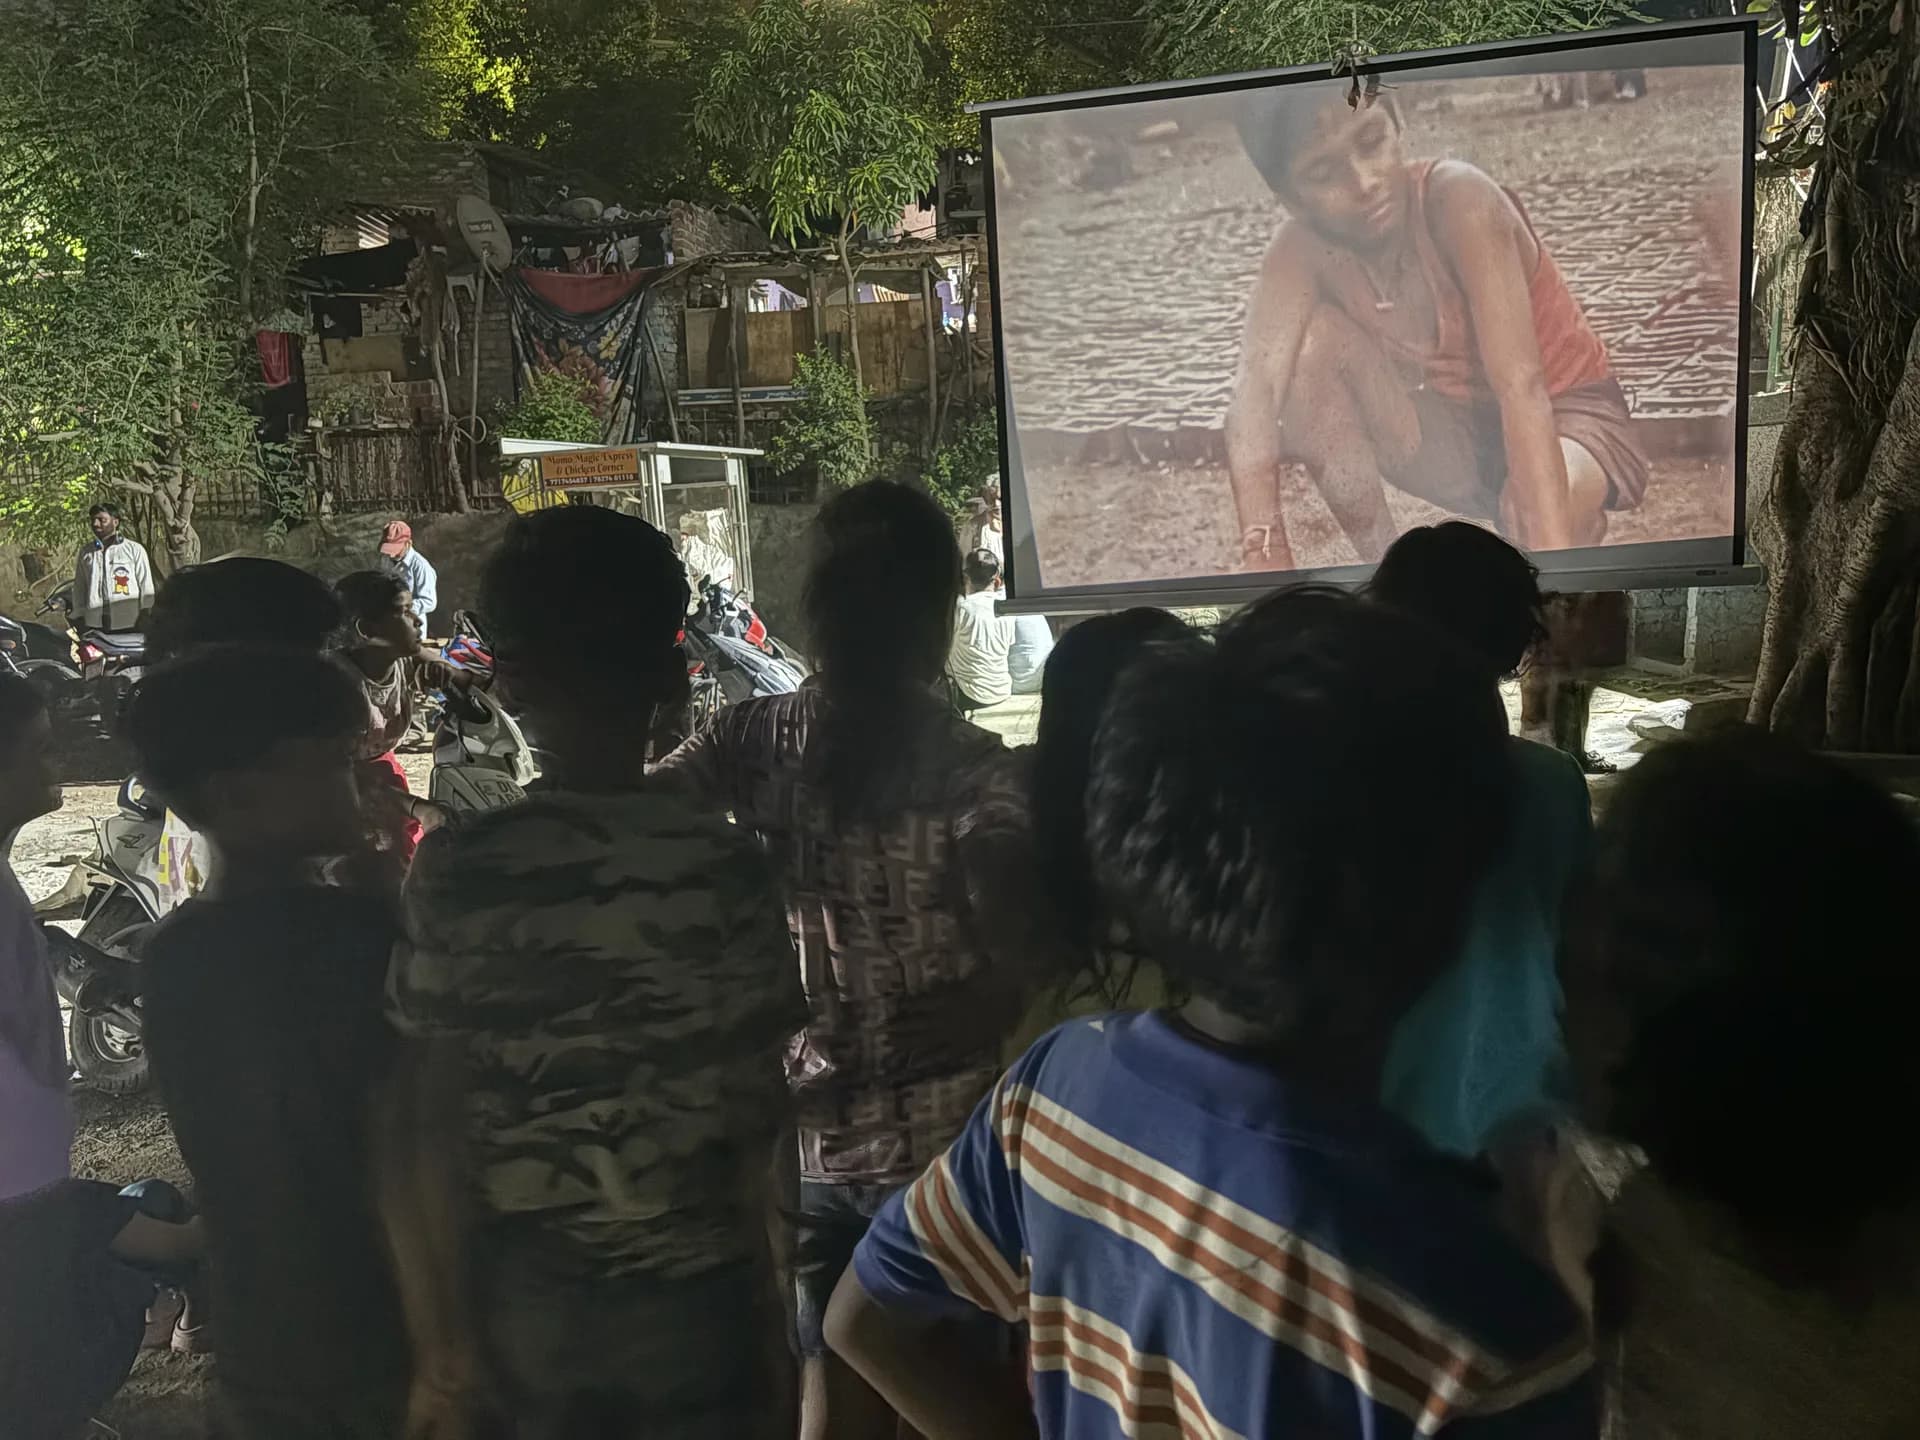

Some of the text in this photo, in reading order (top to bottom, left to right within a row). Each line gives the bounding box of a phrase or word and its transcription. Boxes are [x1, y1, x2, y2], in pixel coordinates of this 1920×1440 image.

[547, 451, 633, 465] Momo Magic Express
[565, 464, 596, 476] Chicken
[597, 463, 625, 474] Corner
